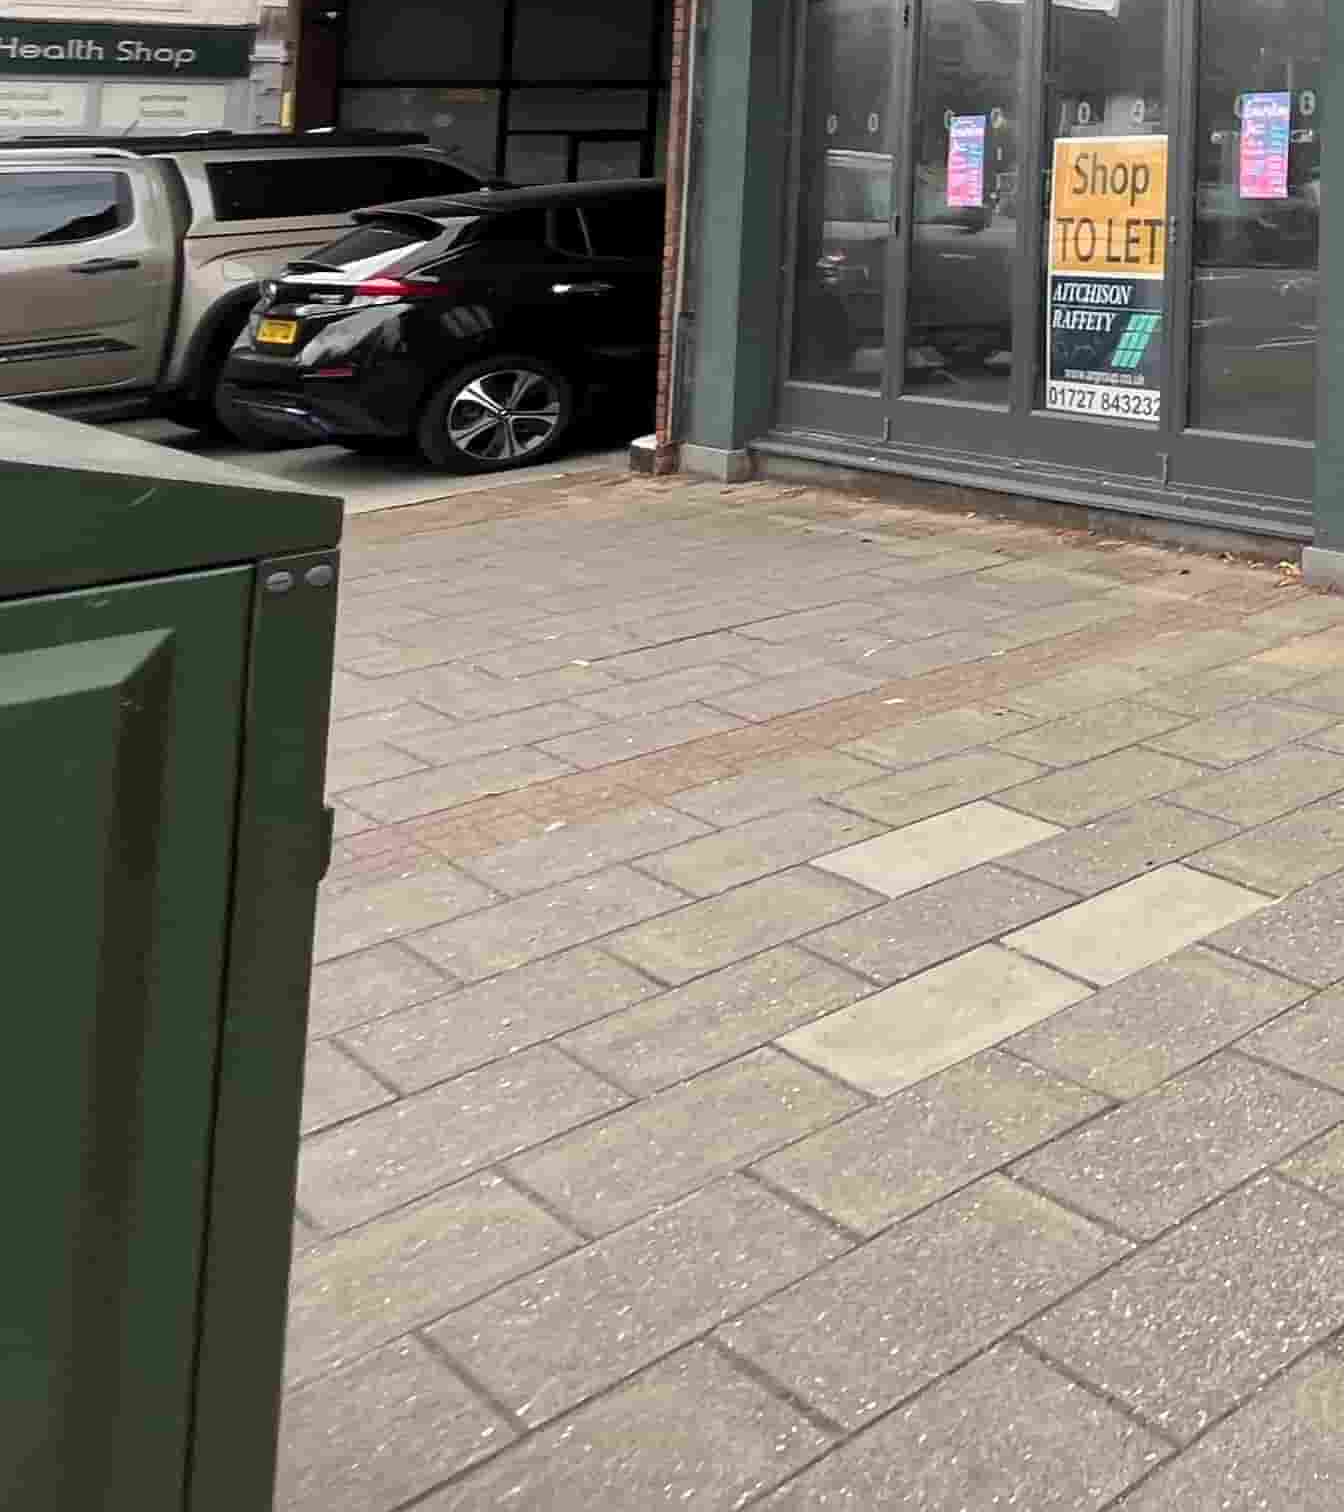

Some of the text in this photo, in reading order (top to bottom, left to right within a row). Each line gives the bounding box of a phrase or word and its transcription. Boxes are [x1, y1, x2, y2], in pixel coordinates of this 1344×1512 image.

[116, 40, 197, 69] Shop
[1071, 152, 1151, 207] Shop
[1056, 217, 1163, 264] TO LET
[1052, 282, 1134, 305] AITCHISON
[1052, 309, 1116, 332] RAFFETY
[1048, 386, 1160, 417] 01727 843232
